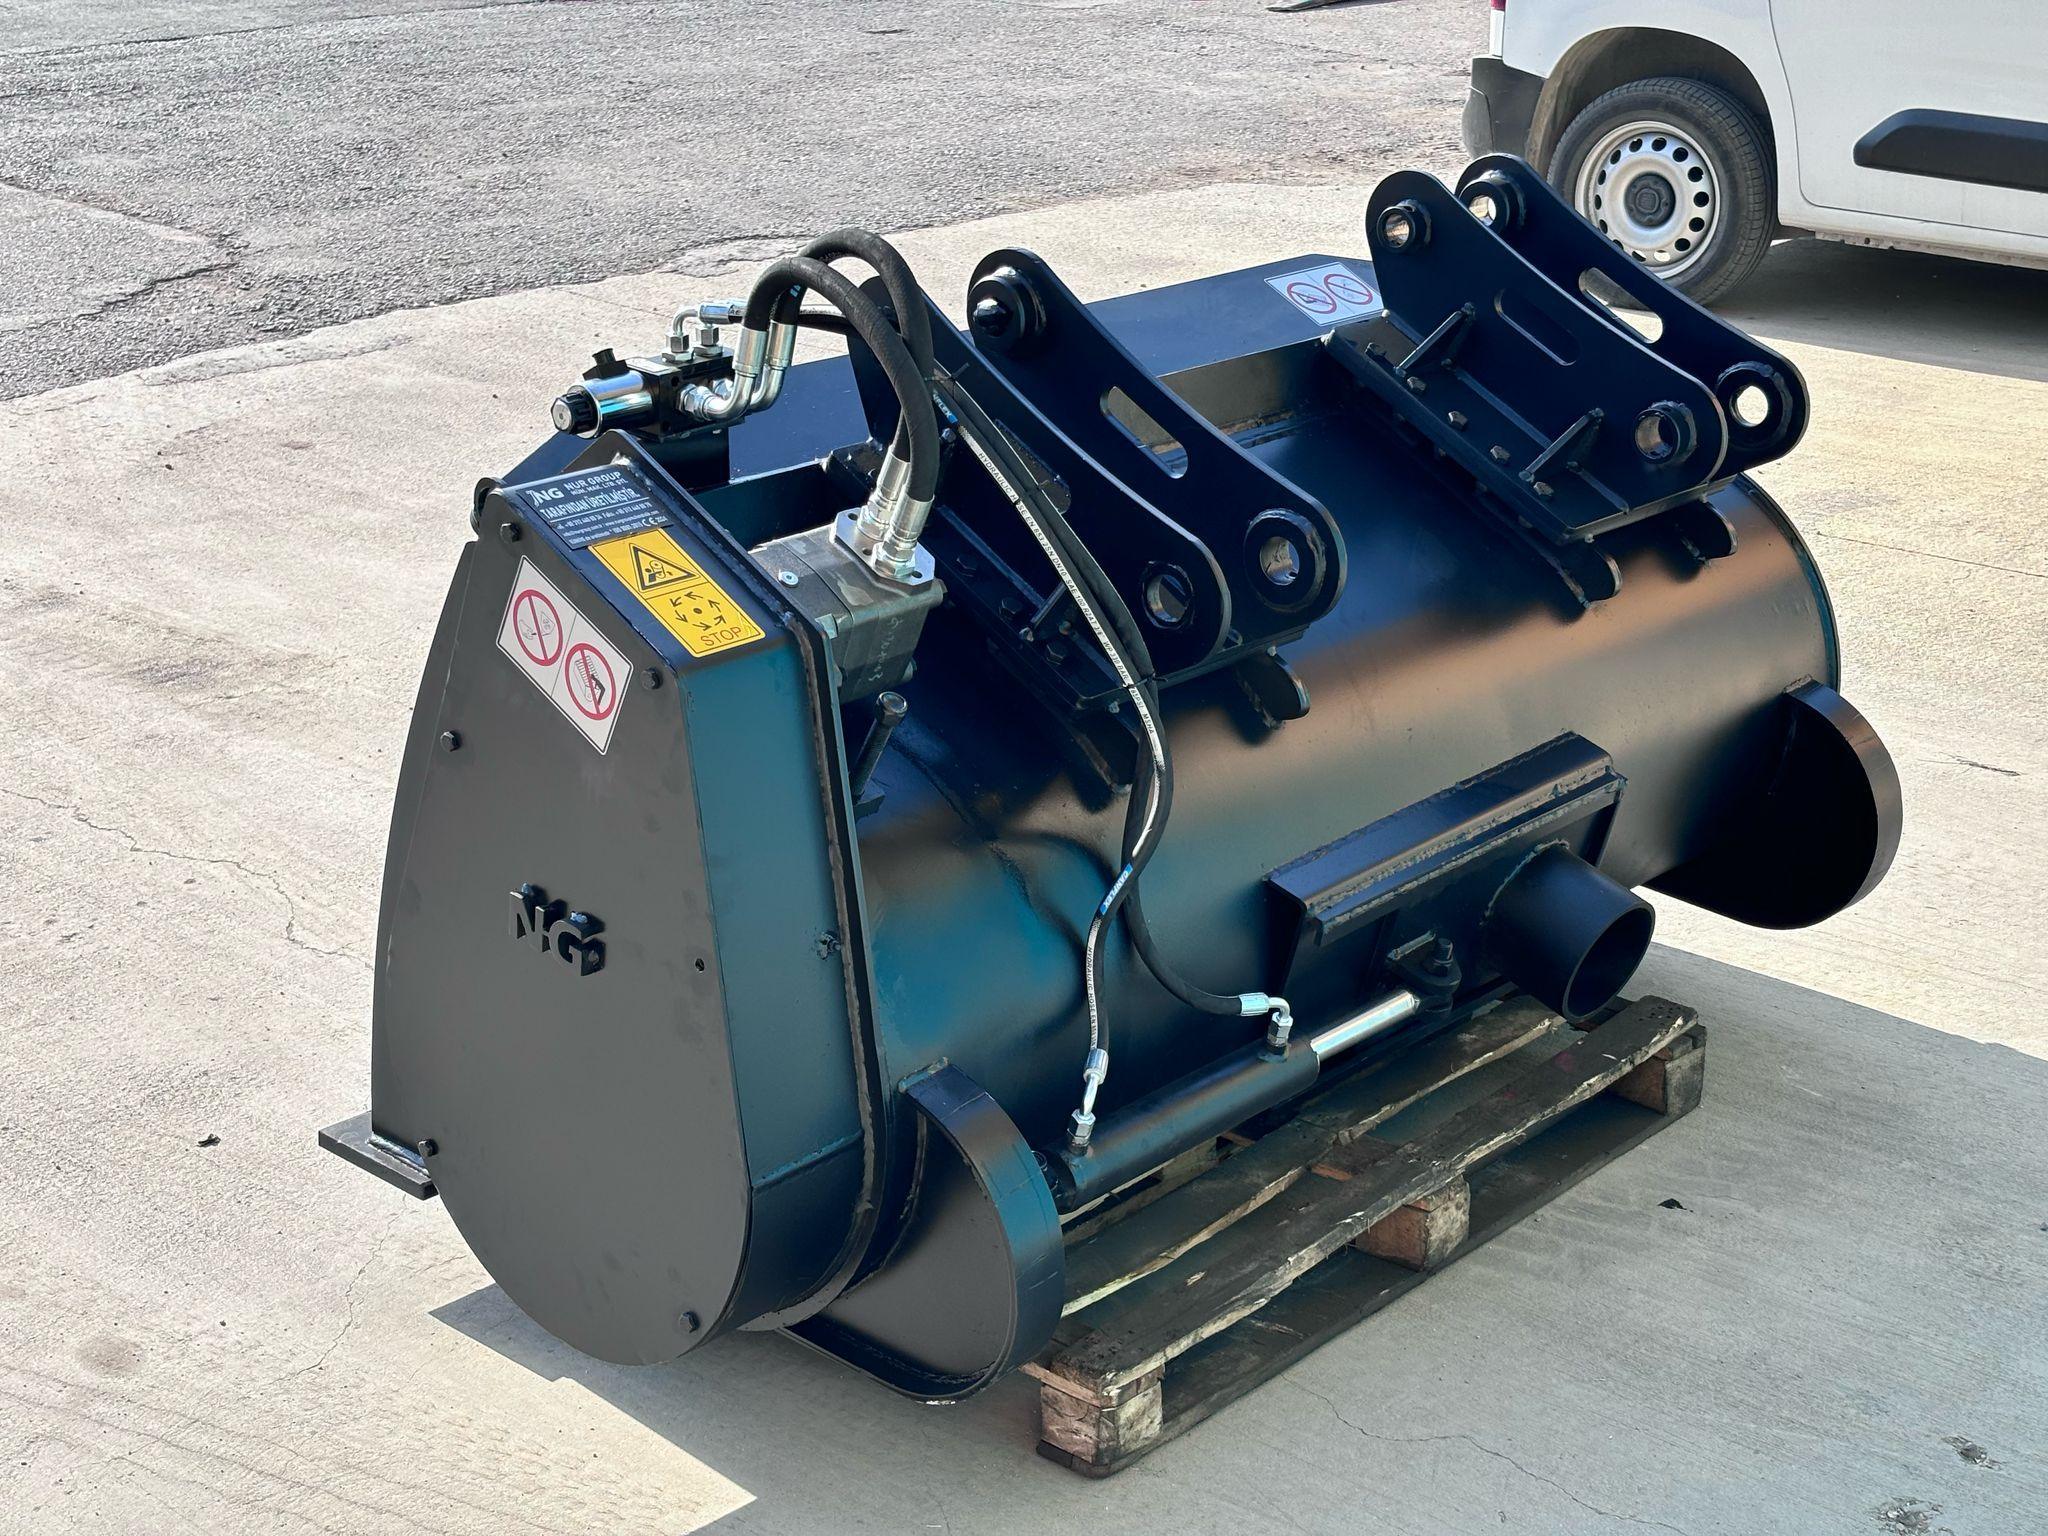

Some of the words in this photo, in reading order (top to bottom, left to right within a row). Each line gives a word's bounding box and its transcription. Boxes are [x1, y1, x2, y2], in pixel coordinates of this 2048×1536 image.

[563, 480, 587, 491] NUR
[587, 471, 621, 486] GROUP
[540, 499, 590, 520] TARAFINDAN
[979, 452, 1012, 494] HYDRAULIC
[1010, 494, 1028, 515] HSE
[1066, 579, 1077, 594] SAE
[1118, 665, 1129, 680] BAR
[1143, 713, 1155, 735] MSHA
[701, 627, 741, 646] STOP
[509, 887, 598, 977] NG
[1086, 946, 1094, 991] HYDRAULIC
